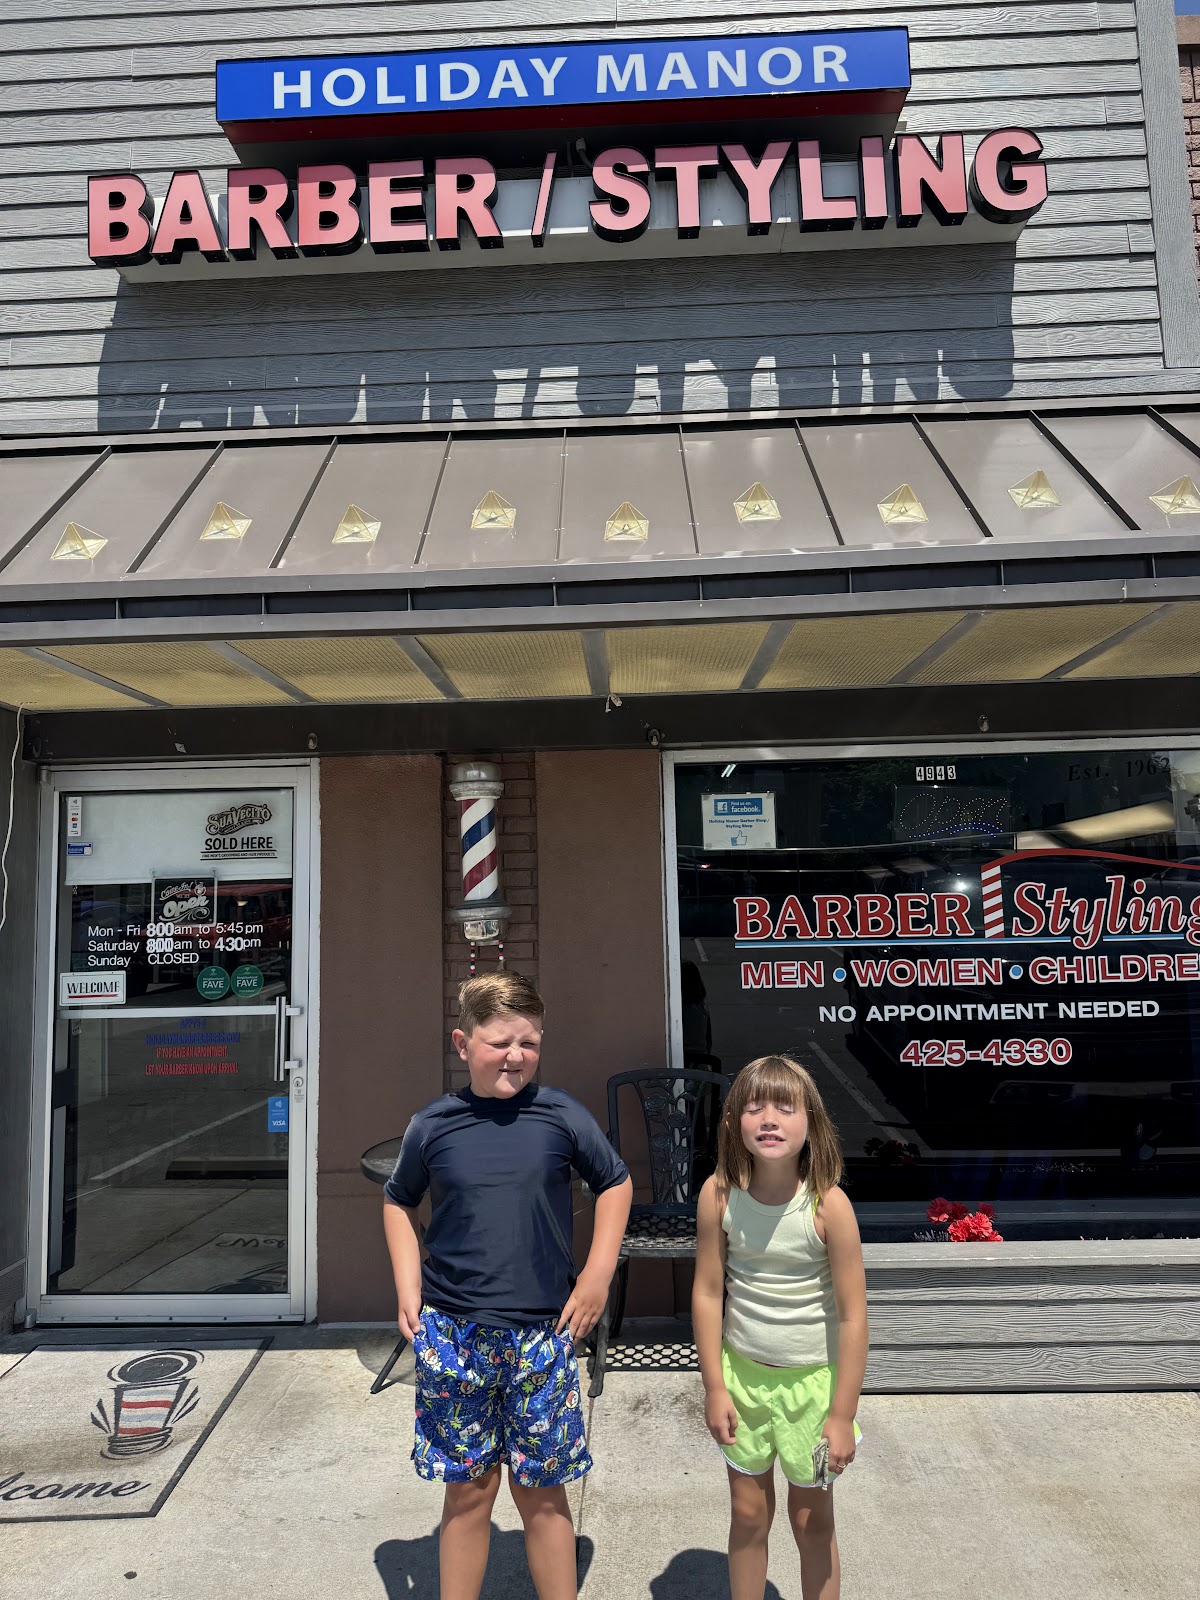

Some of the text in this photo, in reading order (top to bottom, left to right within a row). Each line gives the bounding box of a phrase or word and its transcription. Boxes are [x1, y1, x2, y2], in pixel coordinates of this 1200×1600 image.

[273, 45, 849, 110] HOLIDAY MANOR
[88, 127, 1048, 263] BARBER / STYLING
[916, 765, 956, 781] 4943
[1068, 757, 1171, 781] Est. 1962
[731, 805, 759, 813] facebook
[900, 793, 1007, 833] Open
[205, 836, 273, 850] SOLD HERE
[163, 896, 209, 917] Open
[733, 893, 975, 940] BARBER
[88, 925, 114, 937] Mon
[126, 924, 141, 936] Fri
[198, 924, 210, 934] to
[88, 940, 140, 953] Saturday
[198, 938, 211, 949] to
[88, 952, 199, 967] Sunday CLOSED
[741, 953, 1200, 989] MEN WOMEN CHILDRE
[67, 981, 120, 994] WELCOME
[237, 979, 258, 987] FAVE
[818, 1000, 1160, 1022] NO APPOINTMENT NEEDED
[162, 1047, 172, 1058] YOU
[172, 1047, 185, 1058] HAVE
[186, 1046, 193, 1057] AN
[900, 1038, 1073, 1067] 425-4330
[145, 1064, 155, 1075] LET
[156, 1063, 169, 1075] YOUR
[169, 1063, 188, 1075] BARBER
[188, 1063, 203, 1074] KNOW
[204, 1062, 217, 1074] UPON
